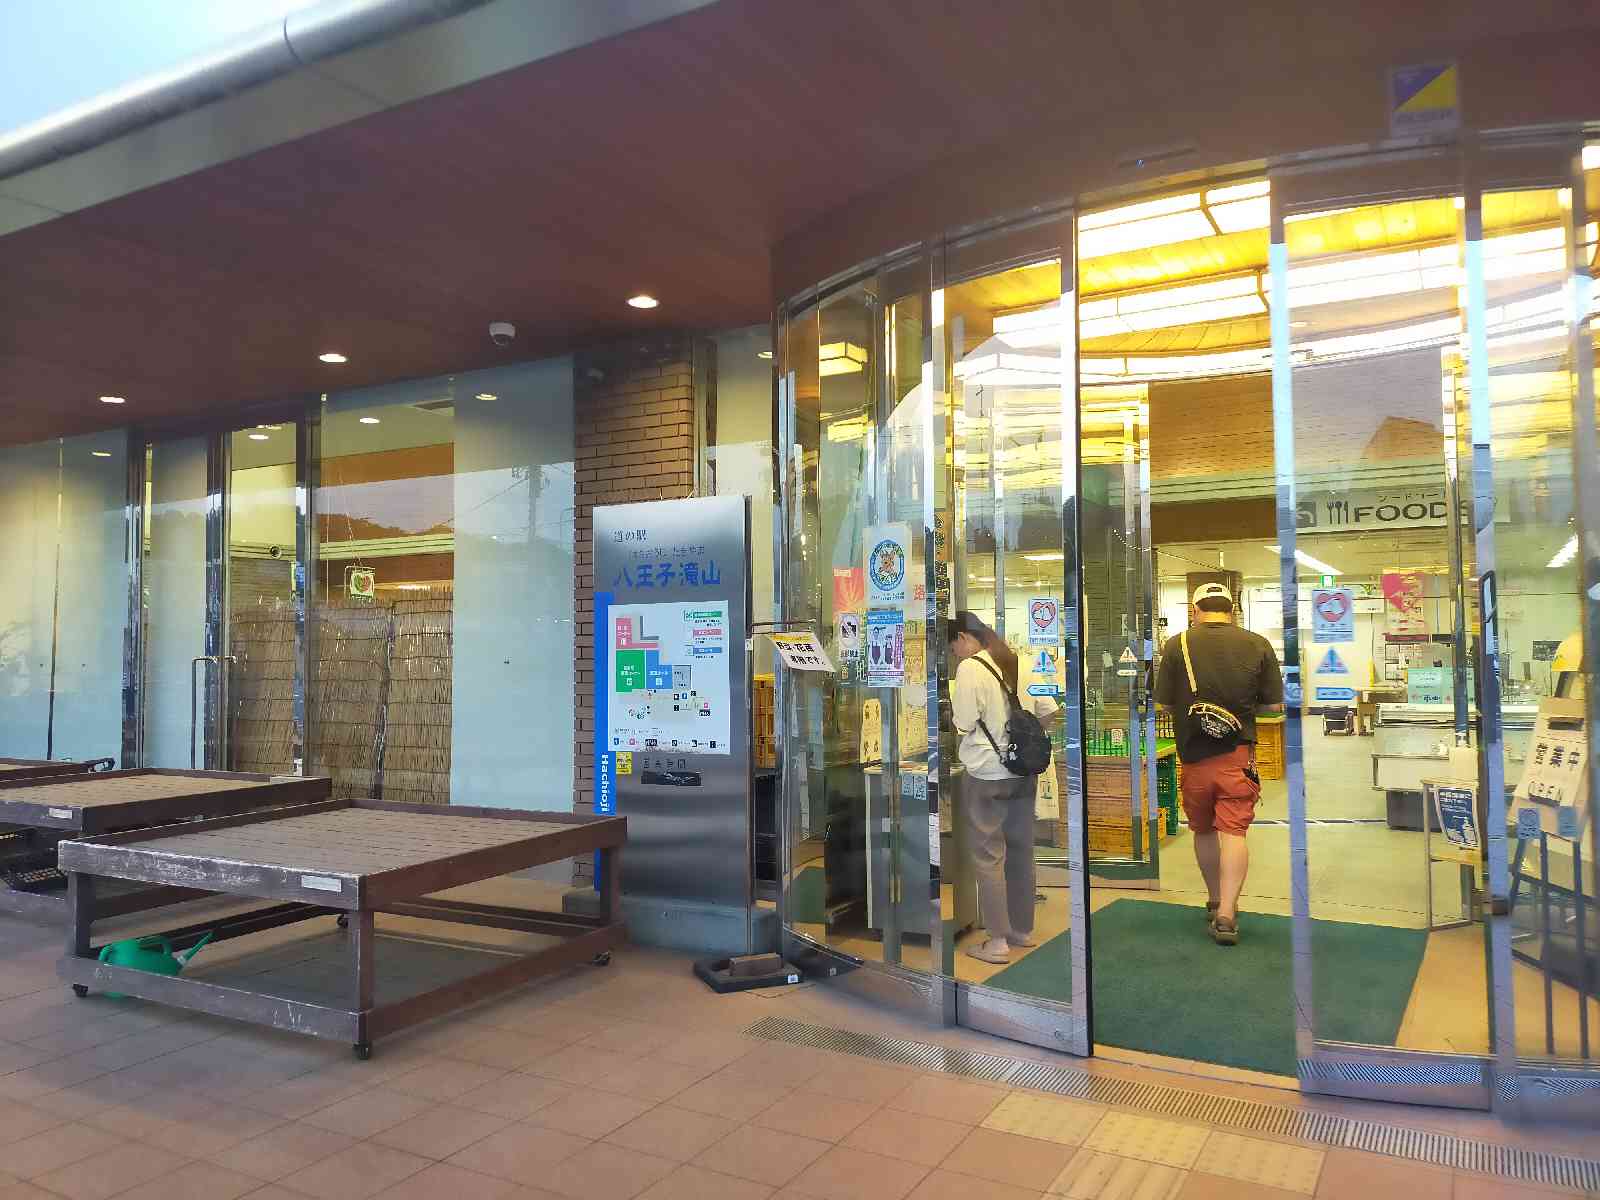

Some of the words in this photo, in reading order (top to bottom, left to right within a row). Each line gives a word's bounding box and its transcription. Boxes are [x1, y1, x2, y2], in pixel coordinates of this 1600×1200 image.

[613, 529, 648, 543] 道の駅
[613, 560, 721, 588] 八王子滝山
[600, 754, 609, 812] Hachioji
